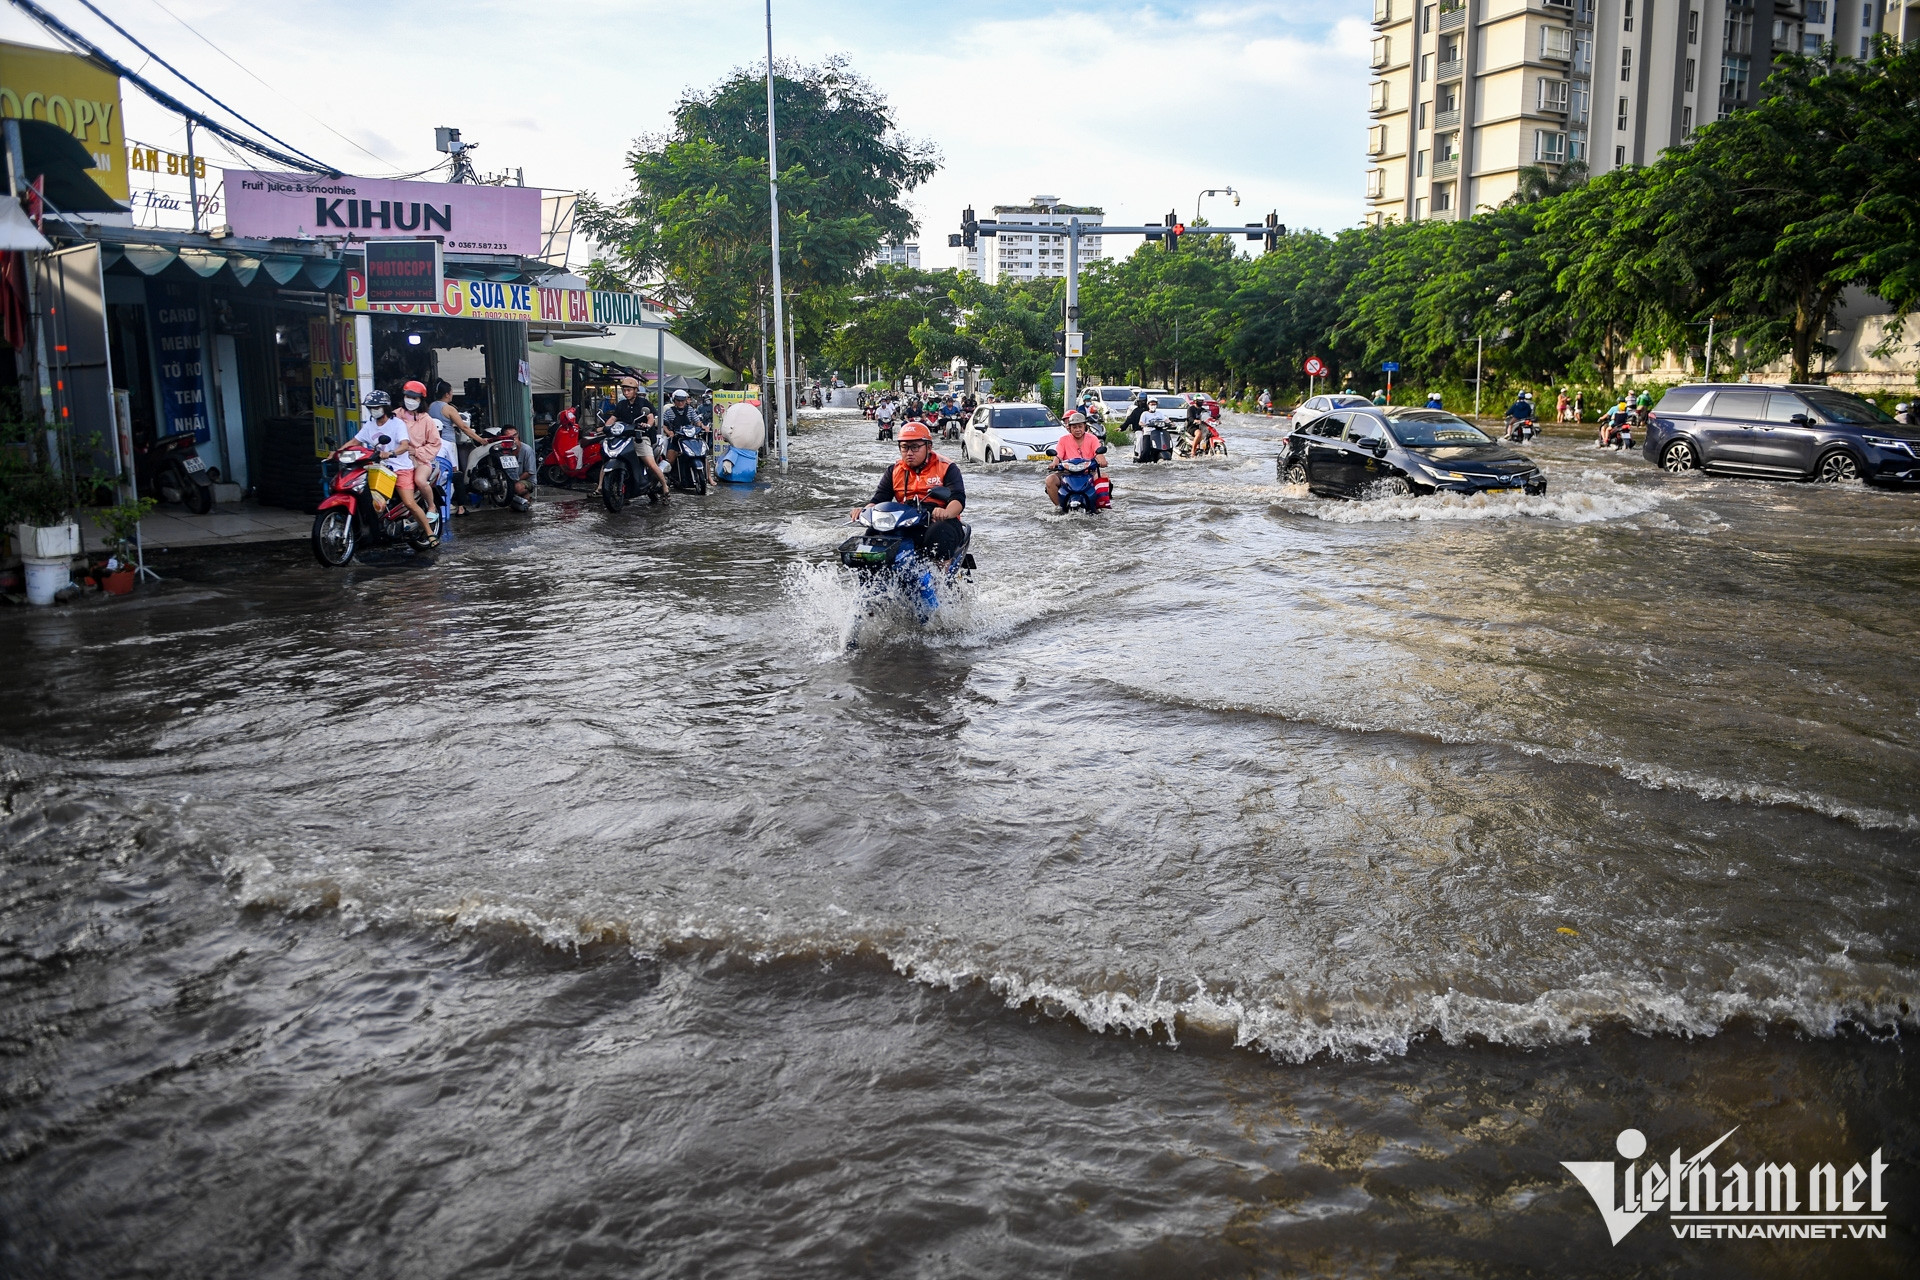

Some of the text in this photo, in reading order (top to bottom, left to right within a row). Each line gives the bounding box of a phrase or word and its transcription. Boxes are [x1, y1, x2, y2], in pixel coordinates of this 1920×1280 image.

[167, 153, 205, 179] 909
[242, 181, 356, 195] Fruit juice & smoothies
[144, 191, 180, 210] Trâu
[316, 197, 451, 231] KIHUN
[458, 242, 507, 250] 0367.587.233
[369, 261, 433, 276] PHOTOCOPY
[510, 285, 531, 310] XE
[537, 287, 562, 320] TAY
[569, 290, 589, 322] GA
[593, 292, 641, 325] HONDA
[159, 308, 196, 324] CARD
[161, 335, 201, 350] MENU
[174, 389, 202, 404] TEM
[926, 475, 942, 485] SPX
